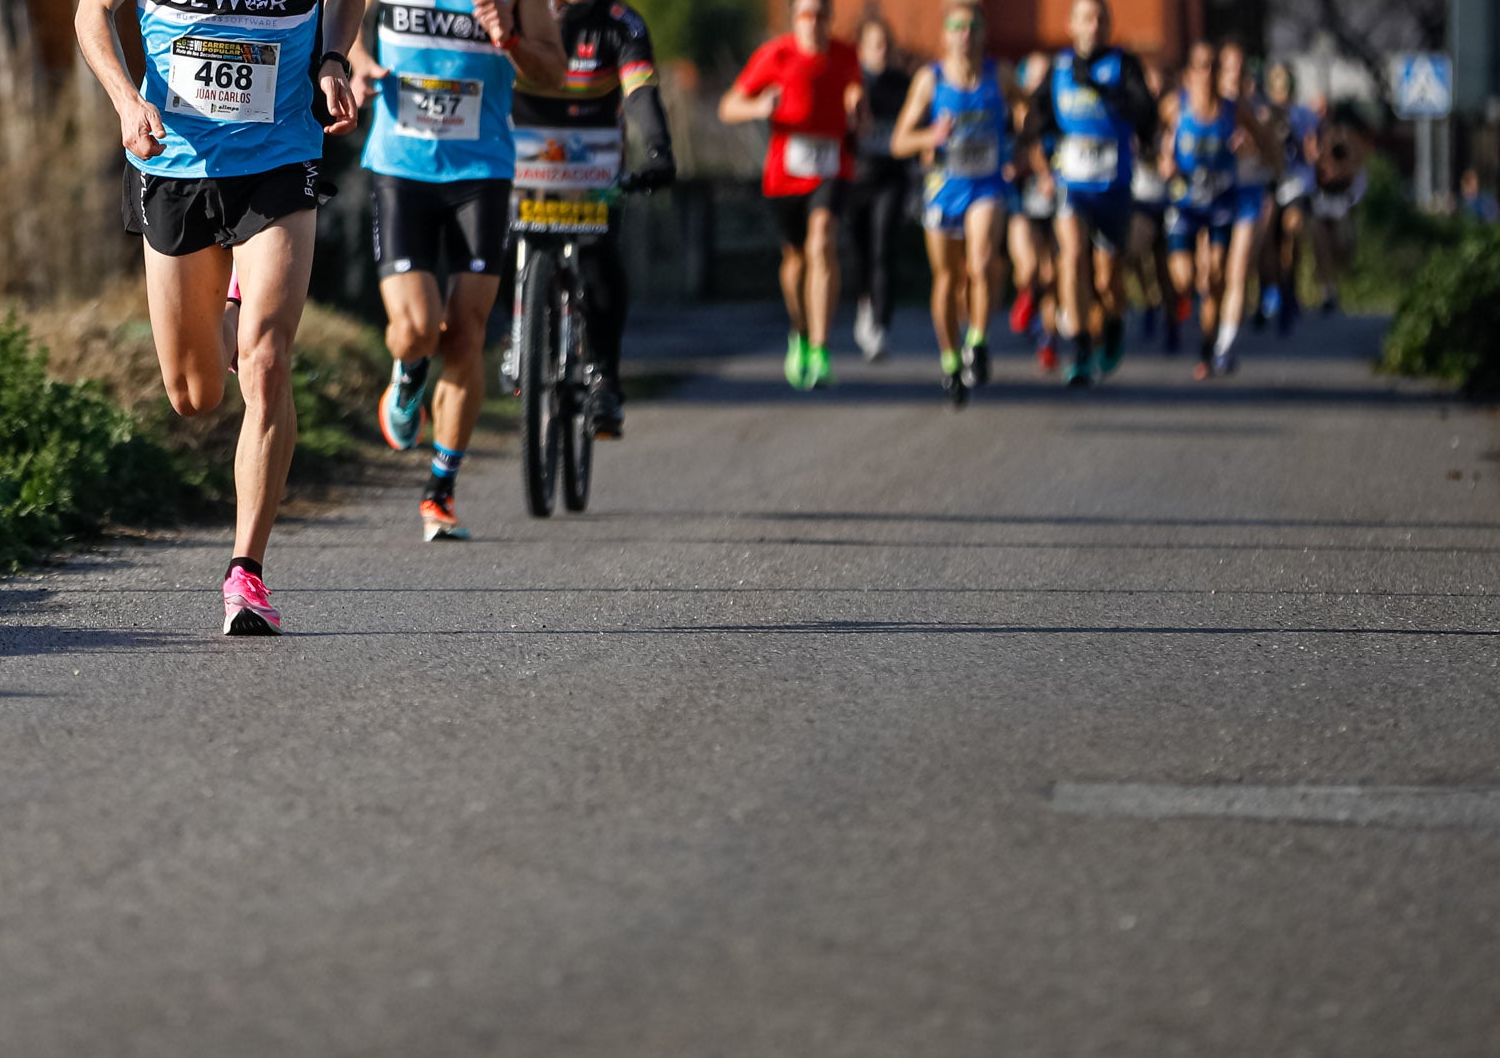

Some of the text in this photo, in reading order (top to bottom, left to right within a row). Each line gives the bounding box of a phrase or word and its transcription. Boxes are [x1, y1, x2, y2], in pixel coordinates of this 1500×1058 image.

[202, 47, 240, 55] POPULAR
[203, 41, 240, 50] CARRERA
[194, 61, 253, 90] 468
[195, 89, 252, 104] JUAN CARLOS
[417, 95, 461, 116] 457
